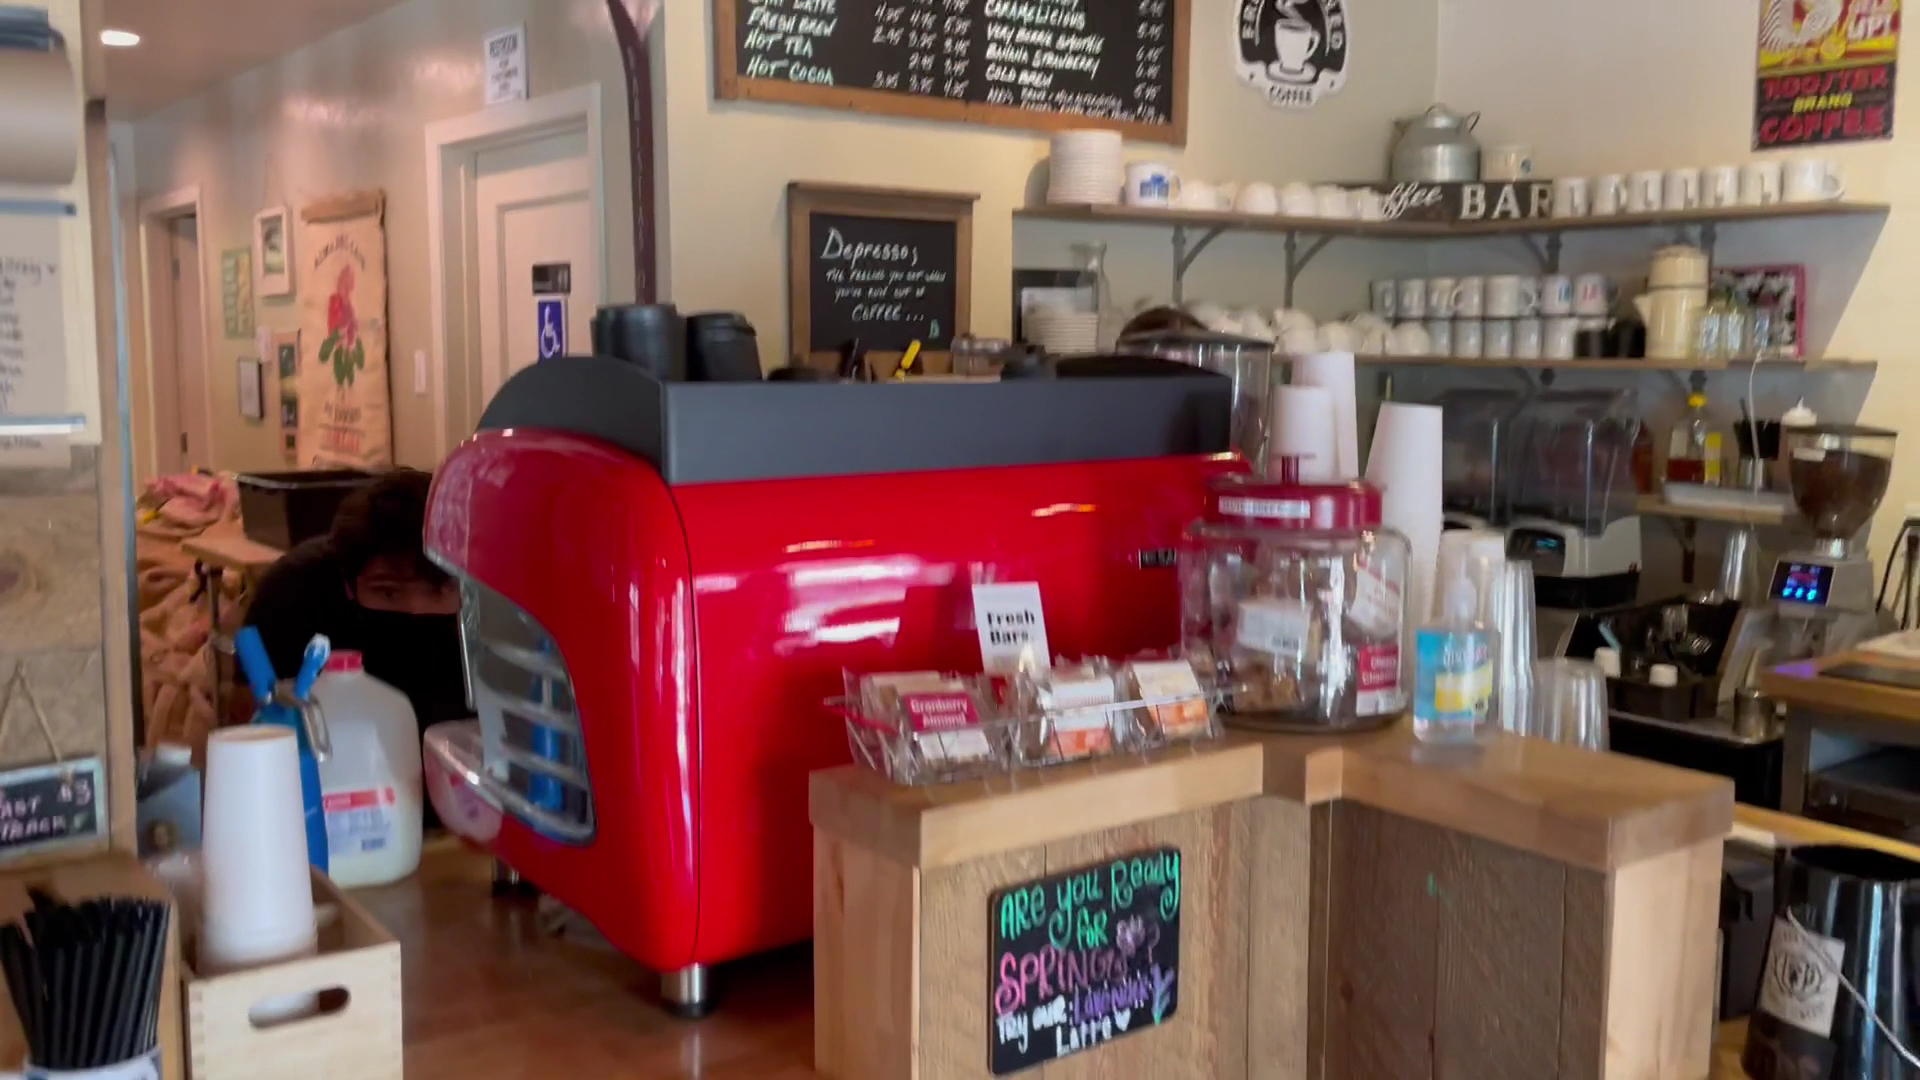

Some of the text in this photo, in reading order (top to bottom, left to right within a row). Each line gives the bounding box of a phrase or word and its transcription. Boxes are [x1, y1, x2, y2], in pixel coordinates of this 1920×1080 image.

[744, 27, 782, 52] HOT
[784, 34, 813, 59] TEA
[746, 54, 789, 79] HOT
[789, 61, 834, 86] COCOA
[1764, 66, 1887, 101] ROOSTER
[1792, 92, 1853, 114] BRAND
[1759, 106, 1885, 143] COFFEE
[1382, 181, 1443, 221] ffee
[987, 608, 1035, 626] Fresh
